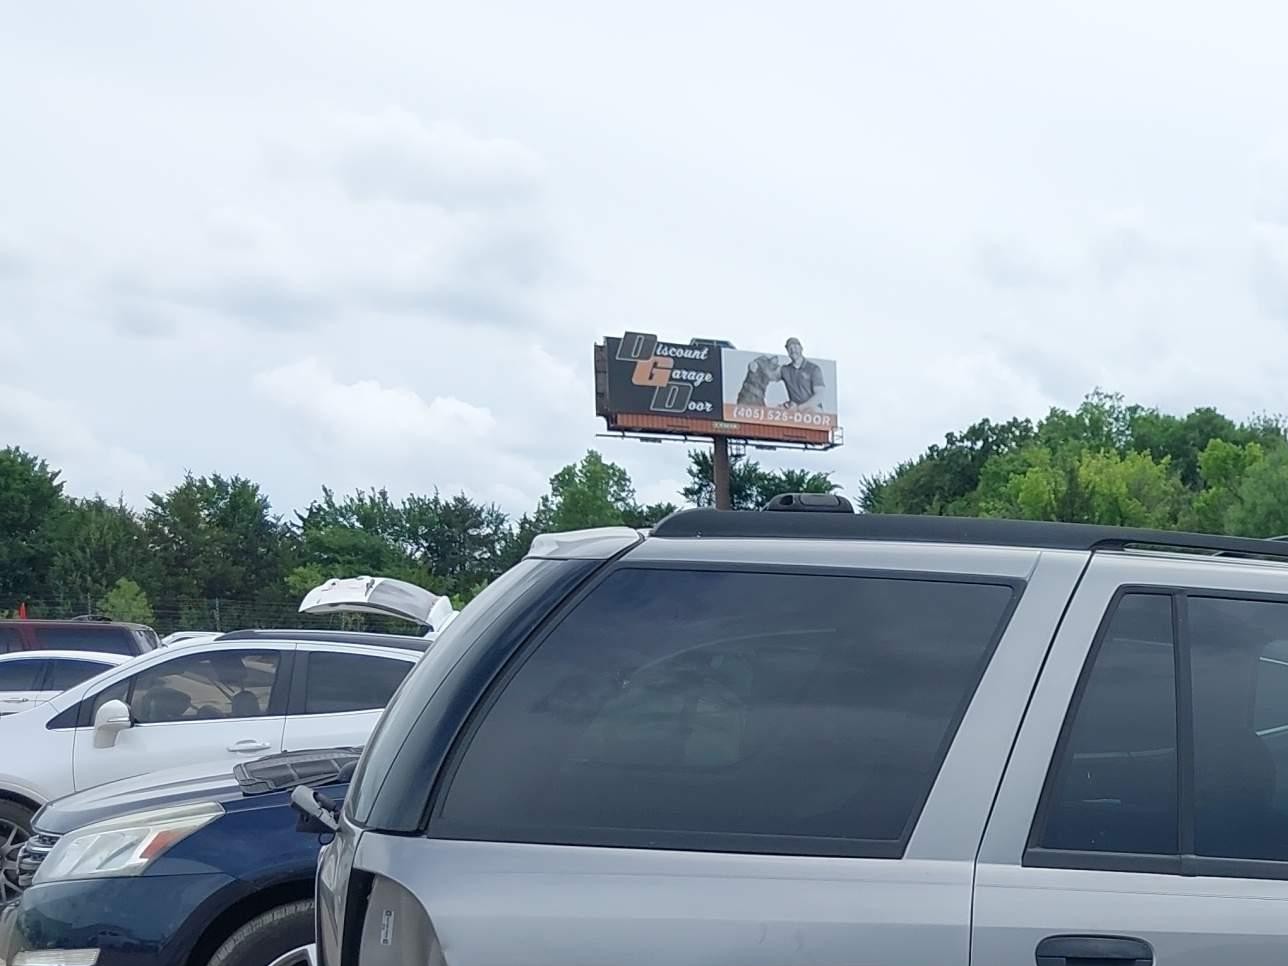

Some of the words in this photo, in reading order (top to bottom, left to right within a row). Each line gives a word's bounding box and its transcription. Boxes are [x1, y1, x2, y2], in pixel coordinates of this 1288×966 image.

[616, 331, 709, 360] Discount
[632, 356, 713, 387] Garage
[650, 382, 713, 412] Door
[733, 406, 764, 420] (405)
[767, 411, 832, 426] 525-DOOR
